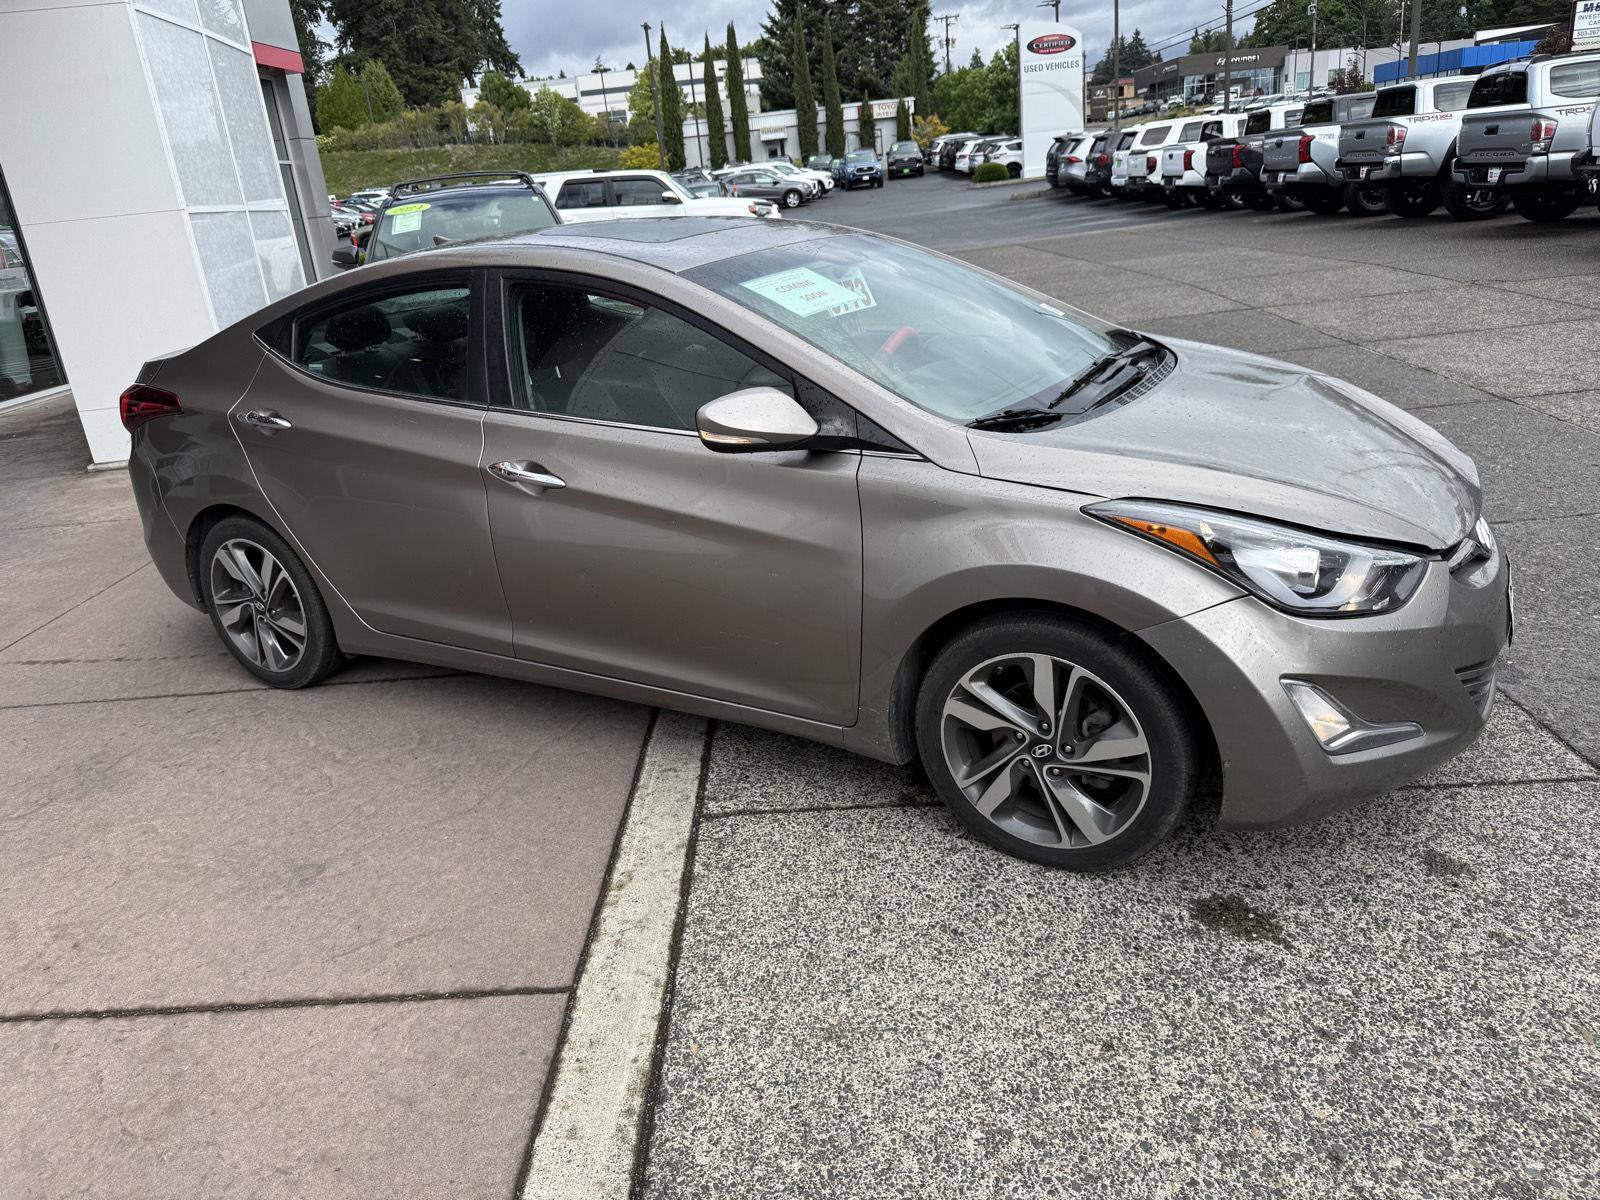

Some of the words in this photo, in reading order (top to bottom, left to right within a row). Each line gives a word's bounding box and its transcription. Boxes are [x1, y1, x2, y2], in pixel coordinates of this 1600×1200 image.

[1023, 63, 1044, 74] USED
[1045, 59, 1080, 71] VEHICLES
[775, 279, 816, 293] COMING
[799, 290, 829, 302] SOON
